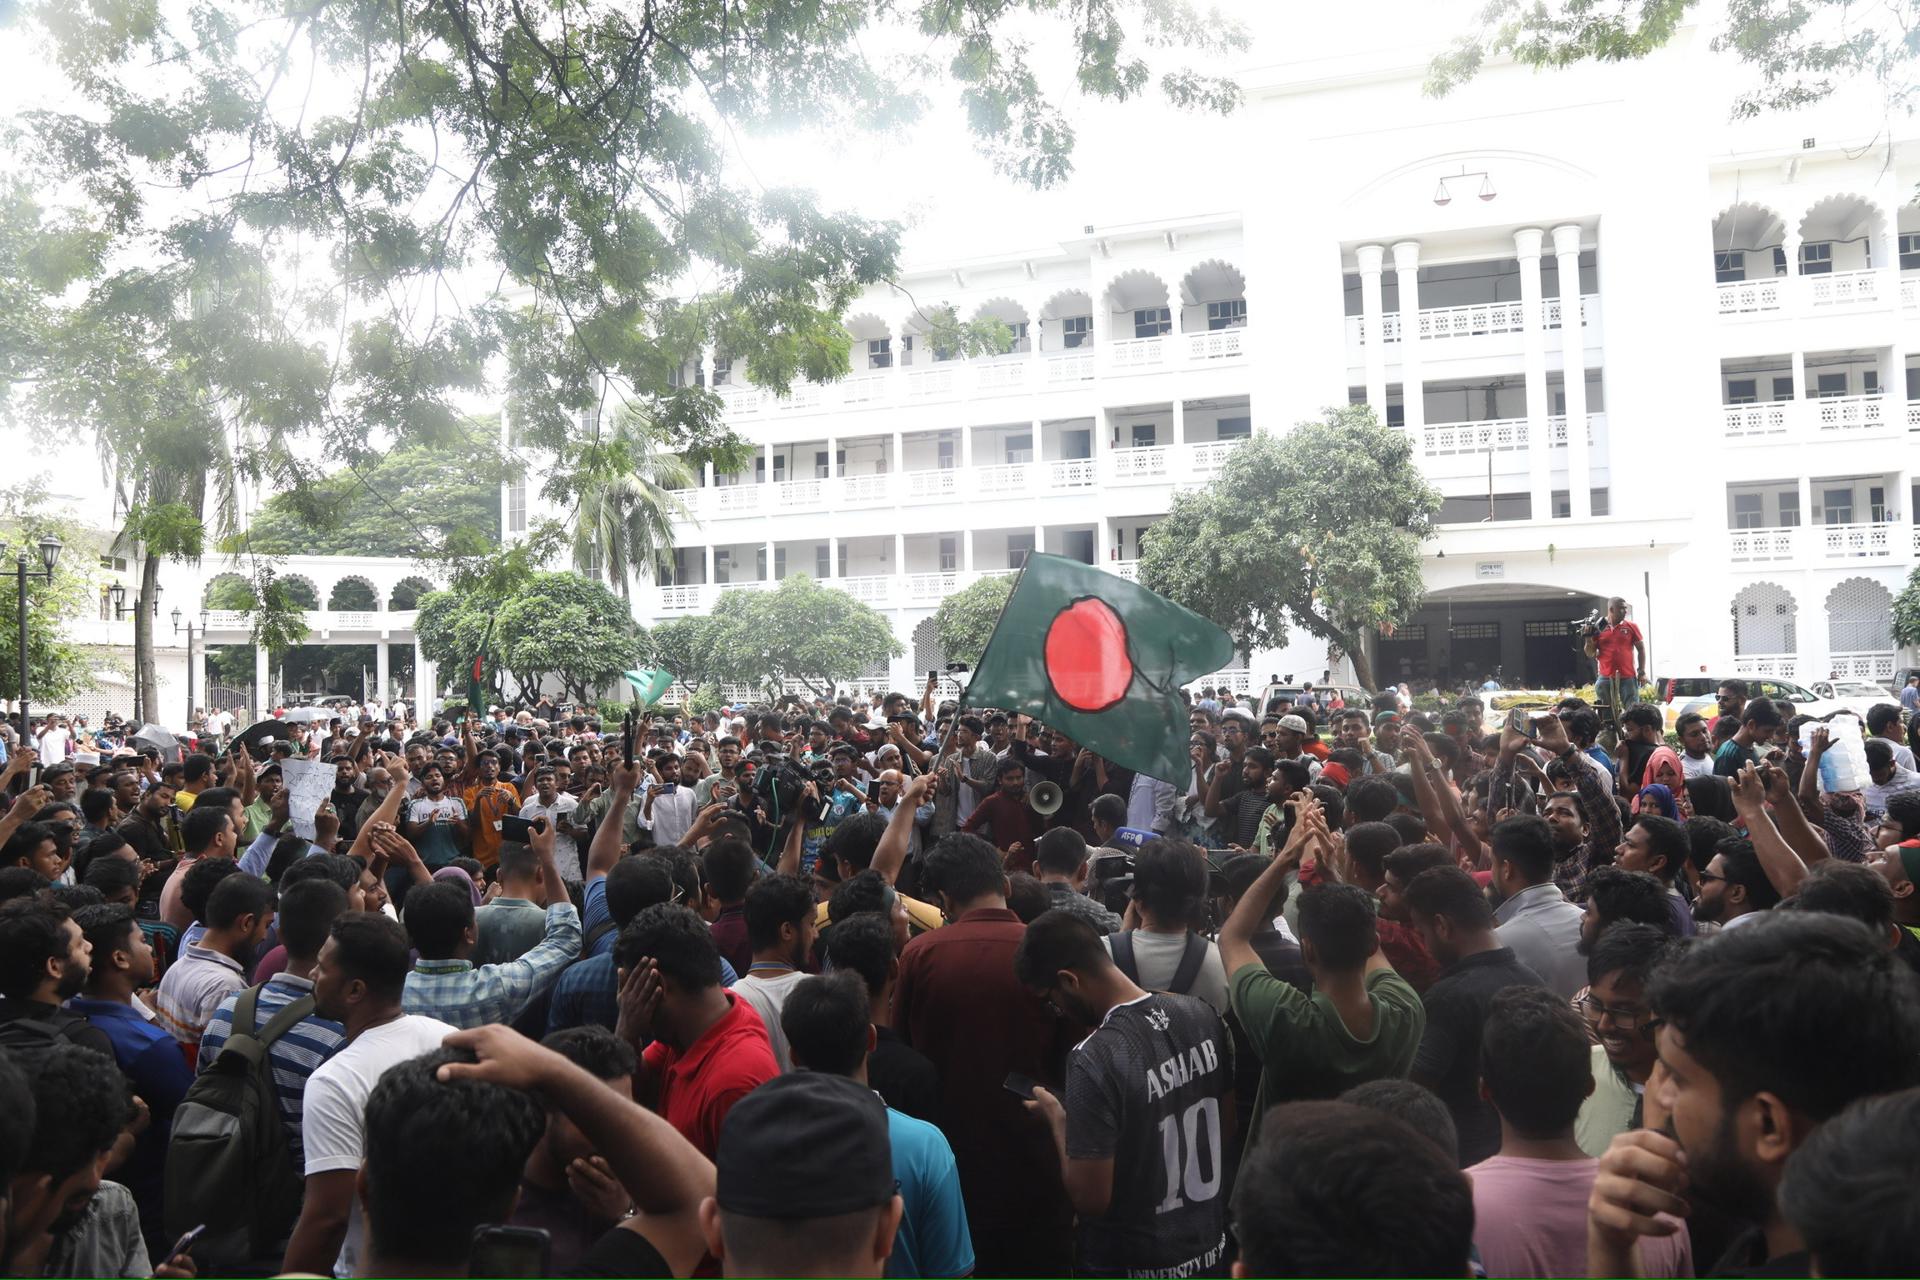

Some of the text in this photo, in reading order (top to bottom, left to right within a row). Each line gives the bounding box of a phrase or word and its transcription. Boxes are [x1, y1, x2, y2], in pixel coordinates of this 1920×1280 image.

[1121, 831, 1136, 841] AFP
[1146, 1038, 1219, 1103] ASHAB
[1155, 1096, 1222, 1215] 10
[1127, 1248, 1218, 1279] UNIVERSITY OF
